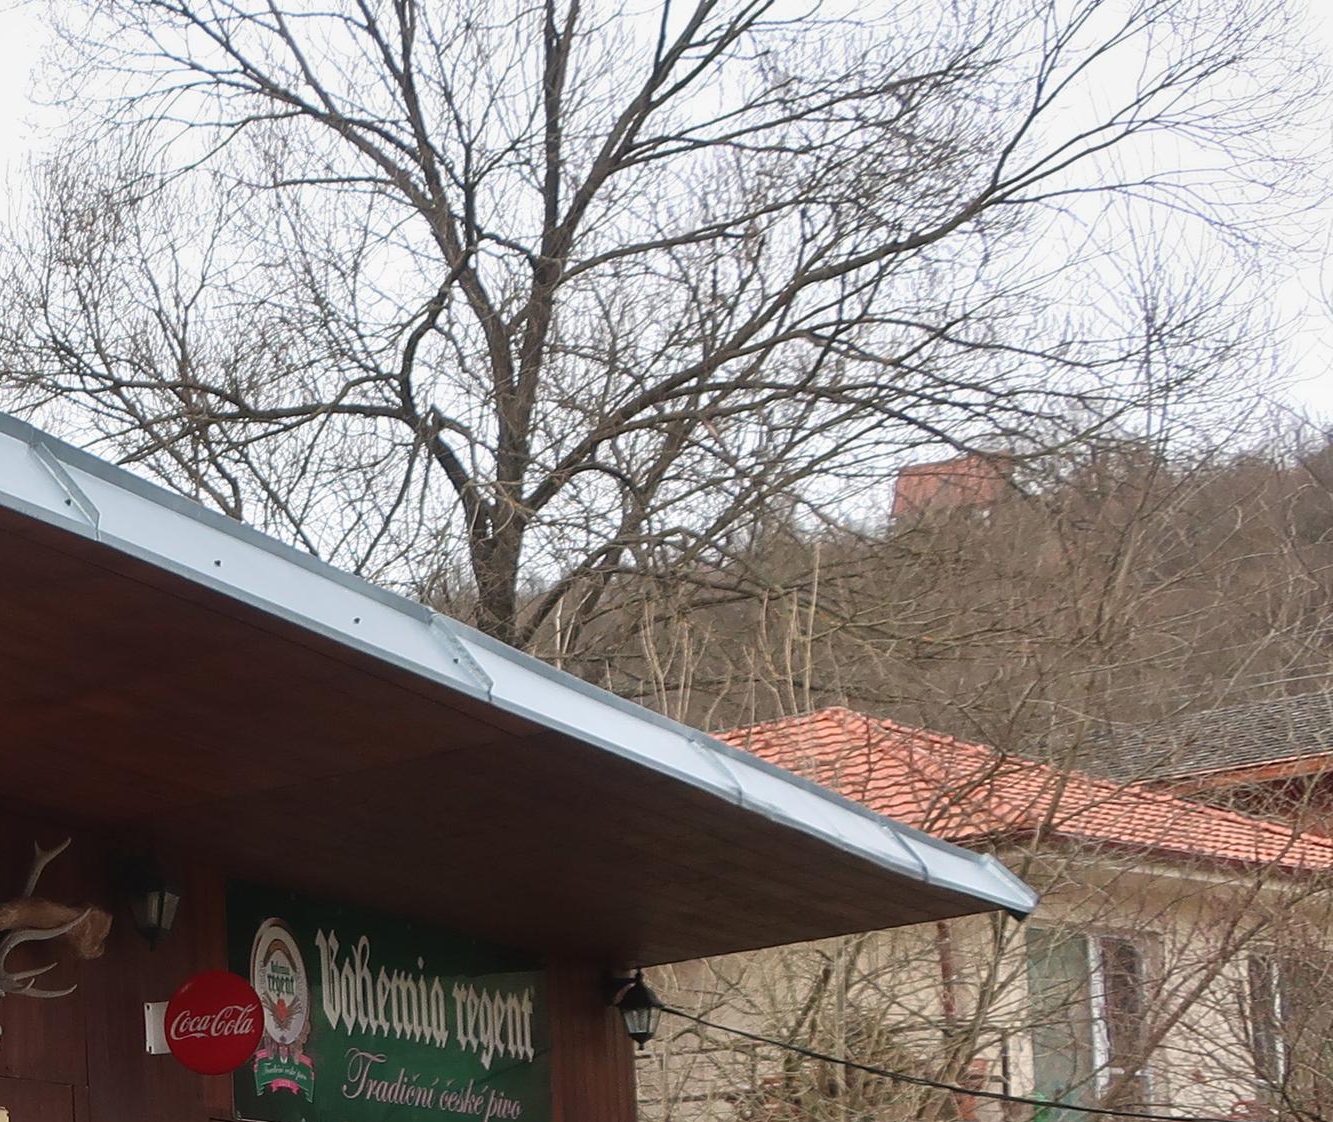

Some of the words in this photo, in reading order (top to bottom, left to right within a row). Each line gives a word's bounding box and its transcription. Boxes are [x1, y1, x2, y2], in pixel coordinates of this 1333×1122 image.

[267, 974, 295, 997] regent
[315, 928, 449, 1048] Bohemia
[452, 981, 535, 1070] regent
[170, 1004, 258, 1041] Coca-Cola
[342, 1047, 435, 1110] Tradiční
[439, 1079, 488, 1116] české
